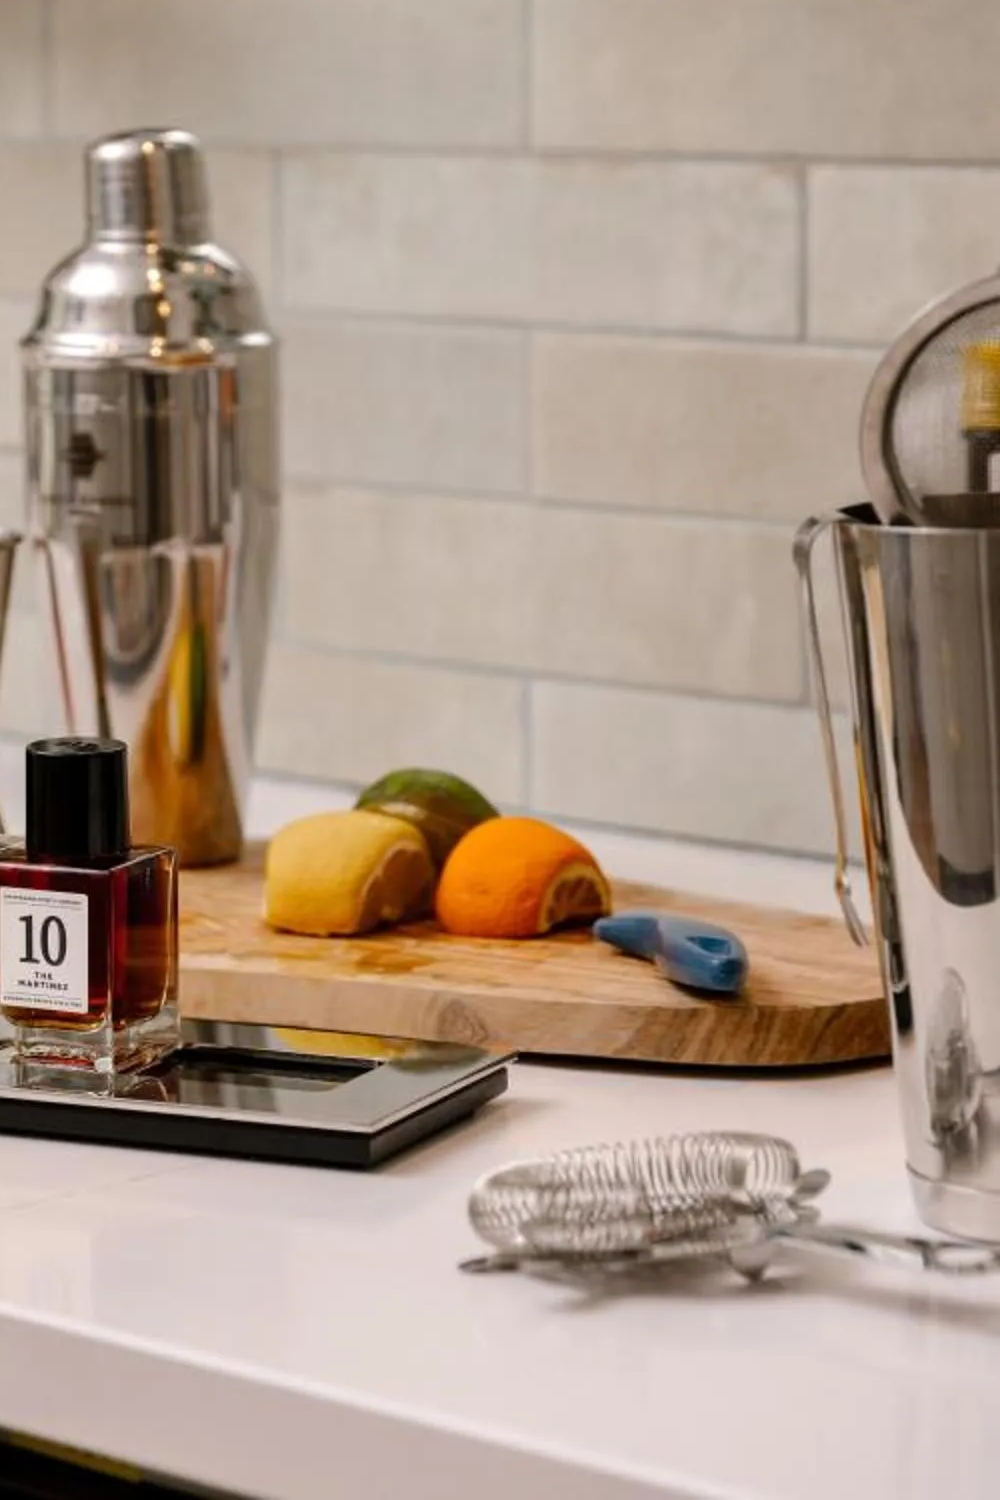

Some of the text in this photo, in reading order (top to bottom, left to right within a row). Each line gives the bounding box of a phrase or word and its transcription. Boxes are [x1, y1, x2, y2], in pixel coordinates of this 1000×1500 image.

[18, 913, 68, 967] 10
[34, 971, 54, 982] THE
[17, 979, 70, 992] MARTINEZ
